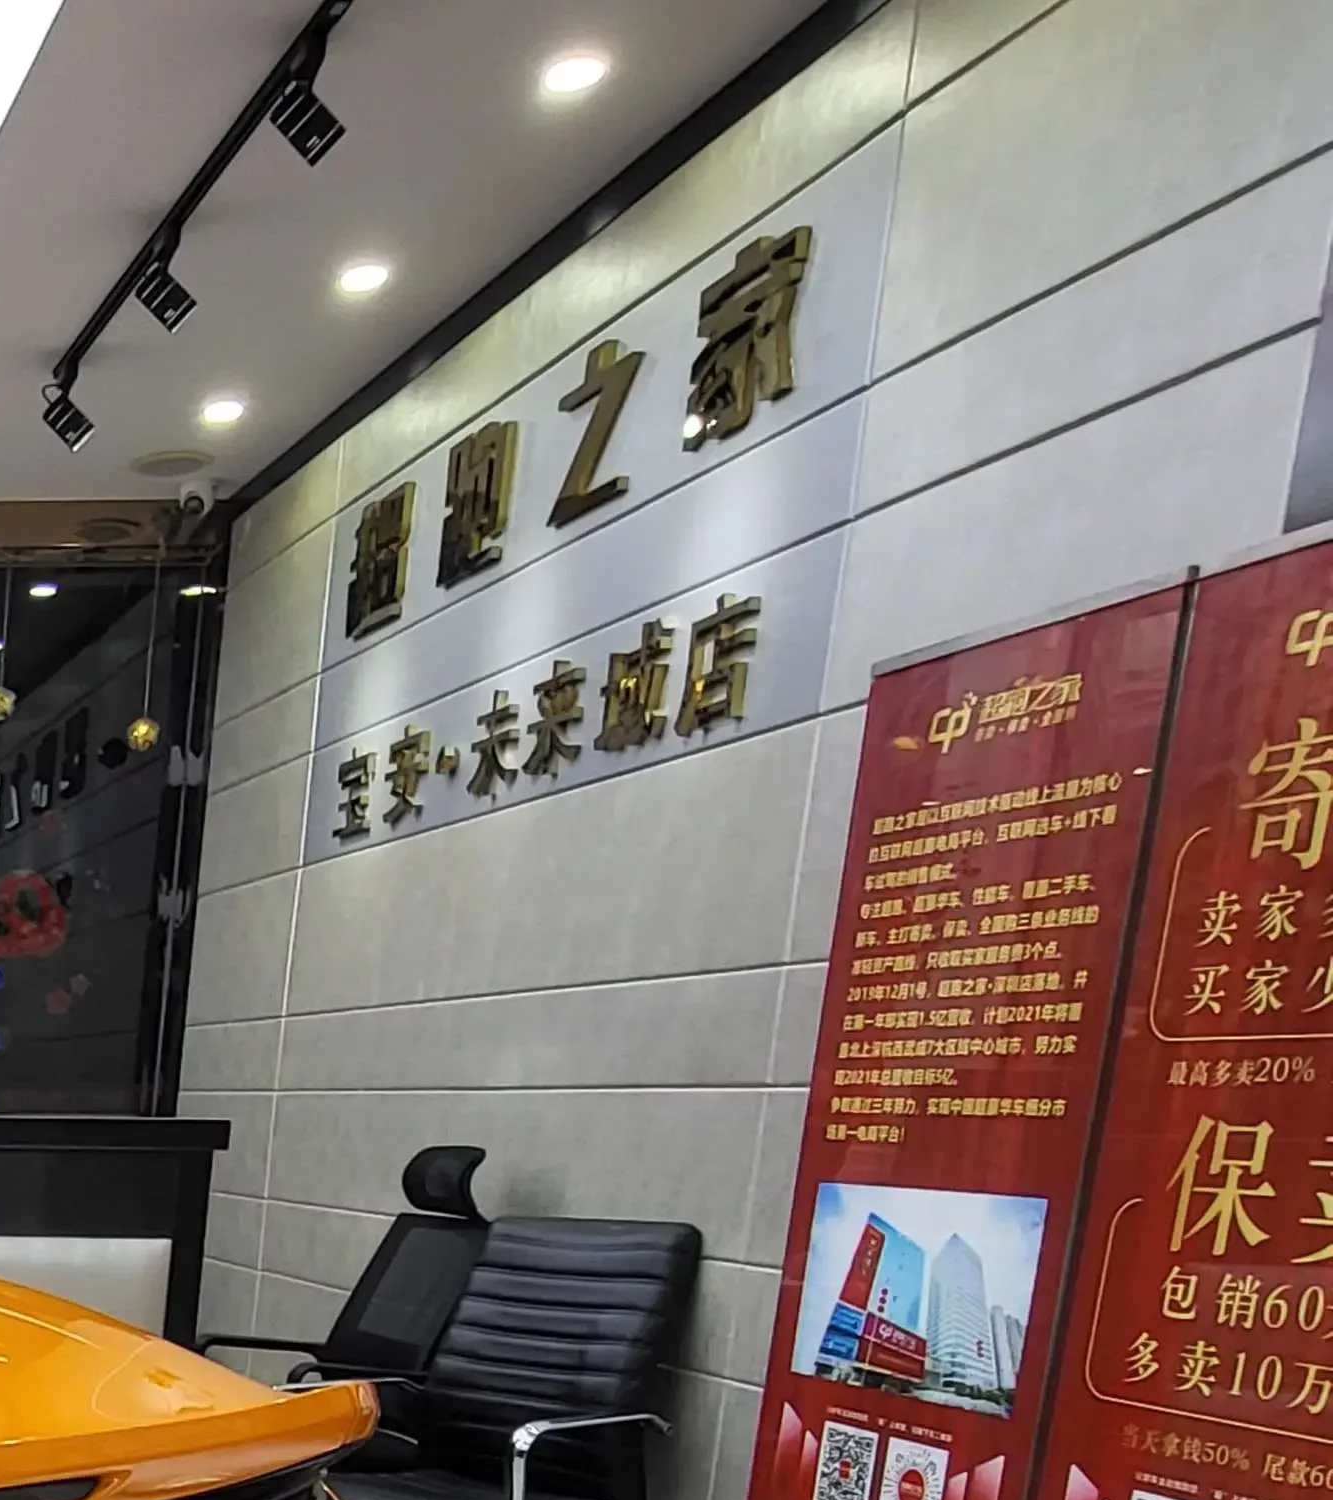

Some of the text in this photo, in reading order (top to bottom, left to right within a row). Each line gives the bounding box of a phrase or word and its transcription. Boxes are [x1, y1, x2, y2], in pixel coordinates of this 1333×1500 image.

[1239, 718, 1333, 870] 寄
[1166, 1056, 1315, 1086] 最高多卖20%
[1161, 1265, 1333, 1340] 包销60
